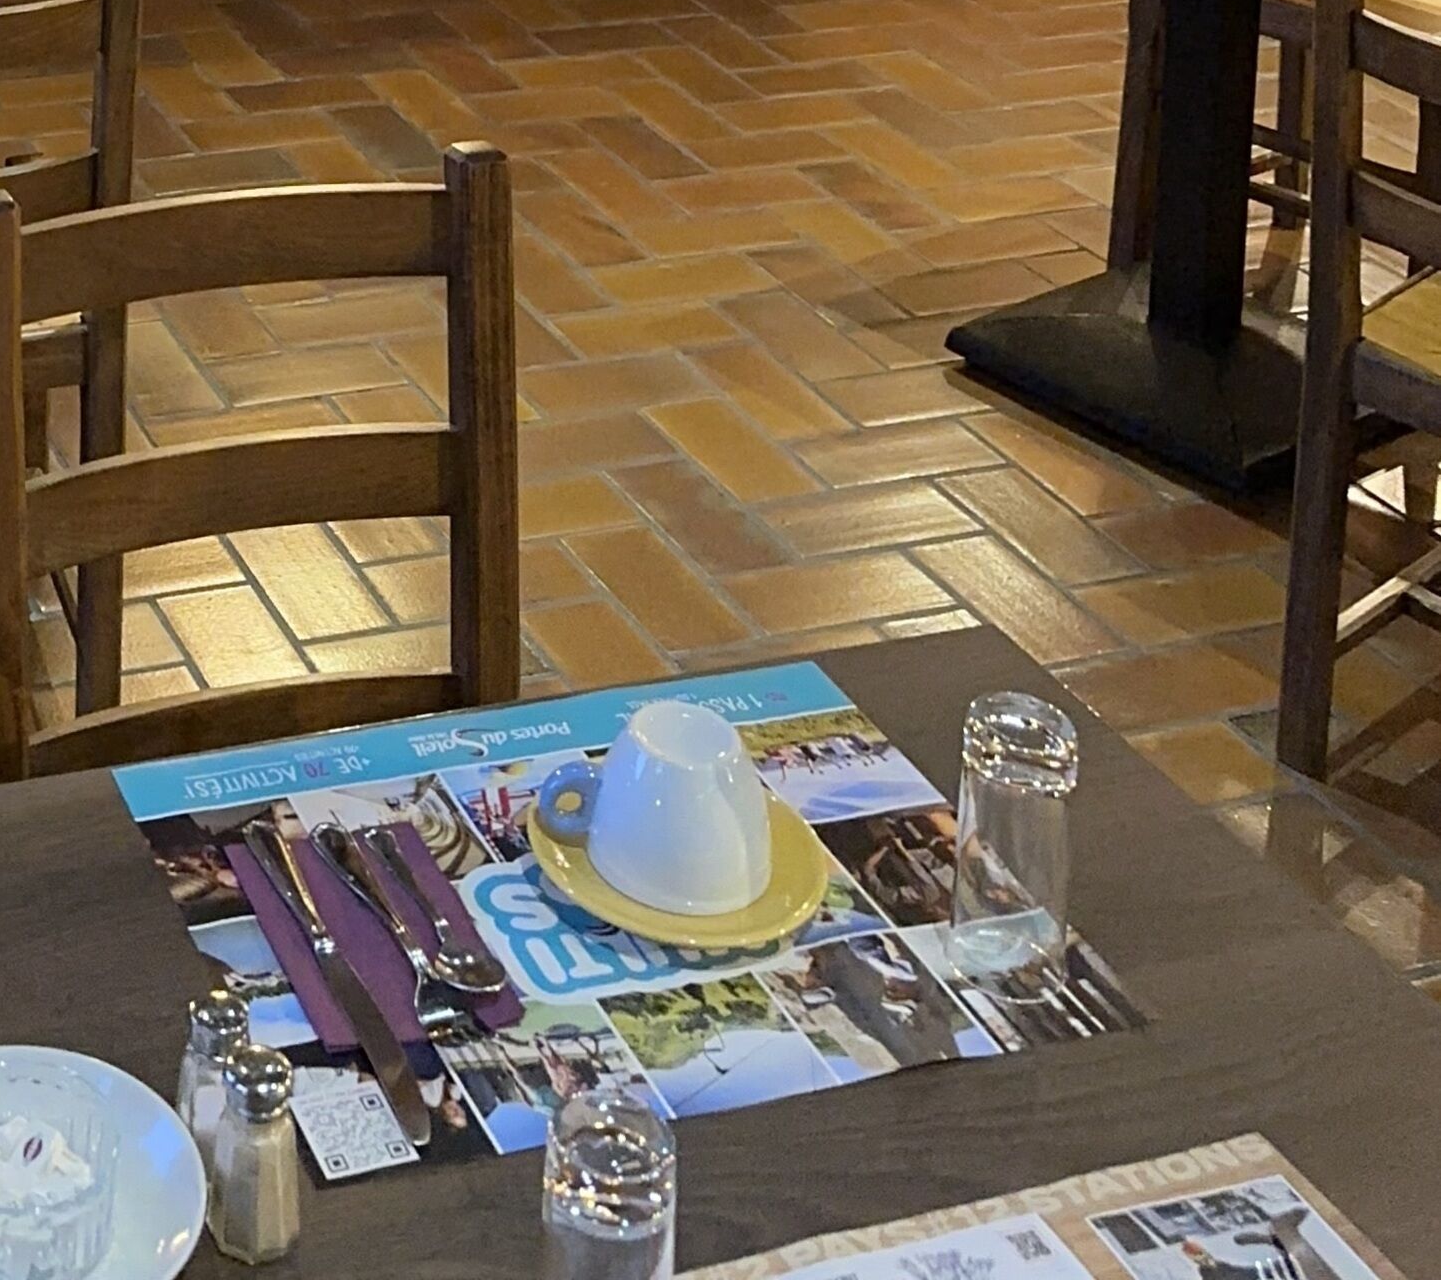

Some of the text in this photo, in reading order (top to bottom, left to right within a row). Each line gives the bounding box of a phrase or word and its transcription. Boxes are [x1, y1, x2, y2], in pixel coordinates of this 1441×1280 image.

[480, 731, 508, 746] du
[510, 721, 571, 740] Portes
[411, 728, 490, 757] Soleil
[303, 760, 331, 779] 70
[1017, 1134, 1275, 1213] STATIONS
